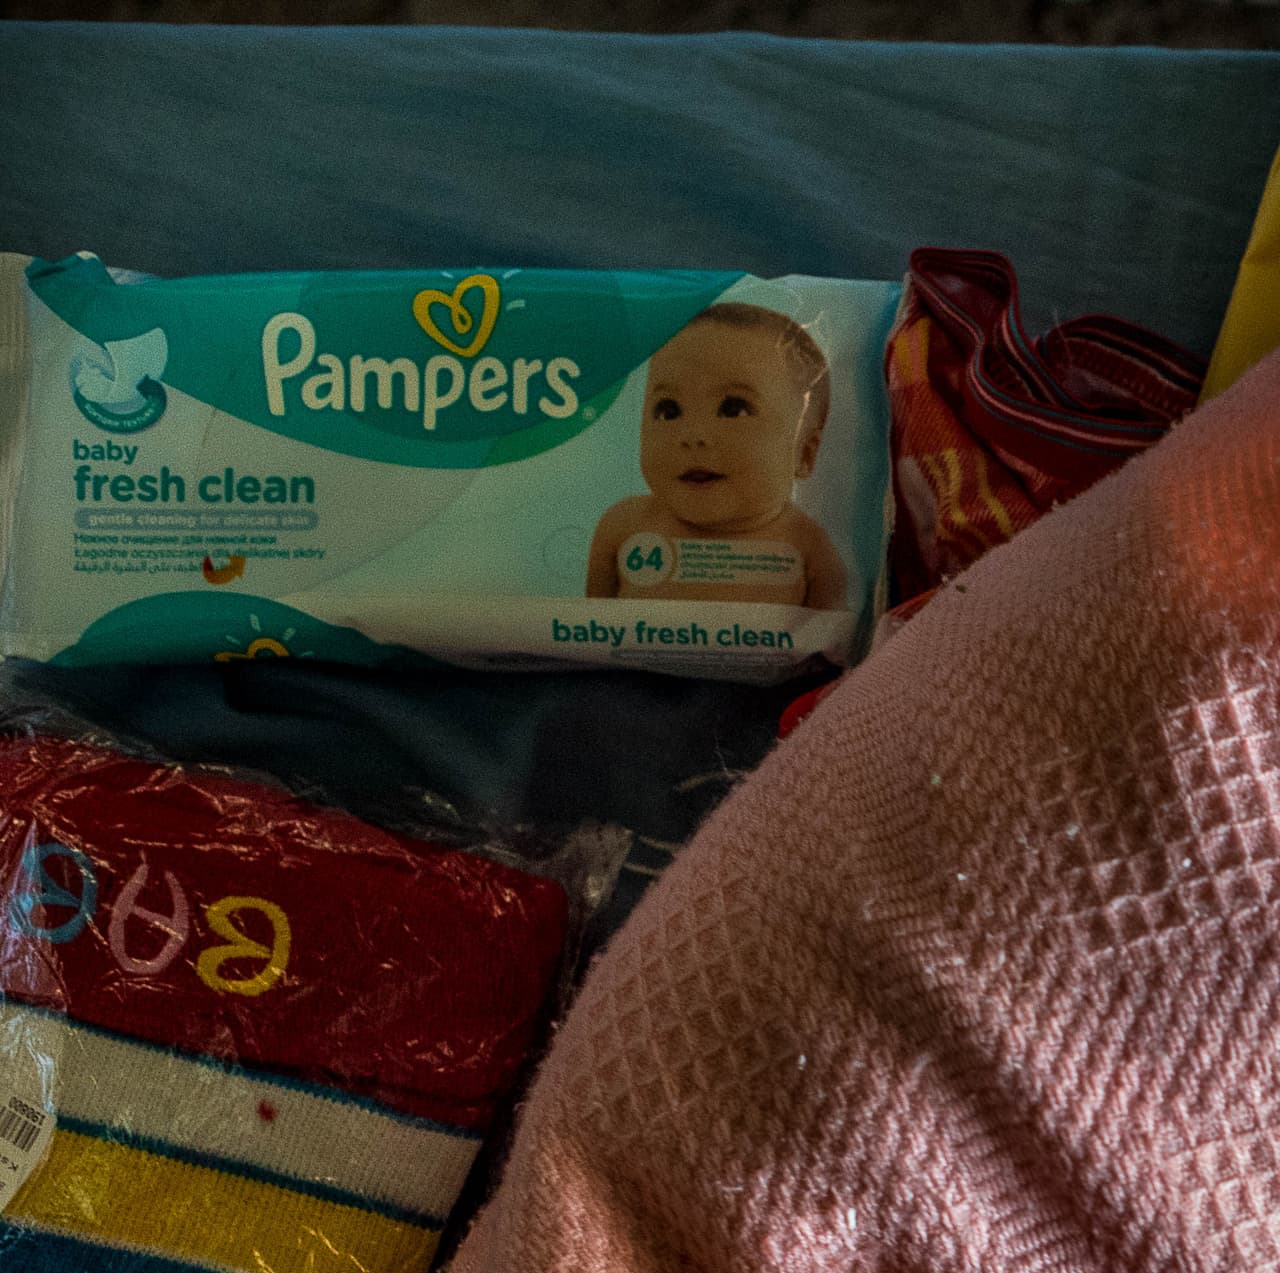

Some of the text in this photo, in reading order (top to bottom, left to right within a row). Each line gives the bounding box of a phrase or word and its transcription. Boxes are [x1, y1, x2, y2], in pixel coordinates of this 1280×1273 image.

[262, 312, 580, 430] Pampers
[73, 438, 138, 465] baby
[74, 465, 316, 504] fresh clean
[626, 545, 664, 571] 64
[552, 618, 794, 649] baby fresh clean
